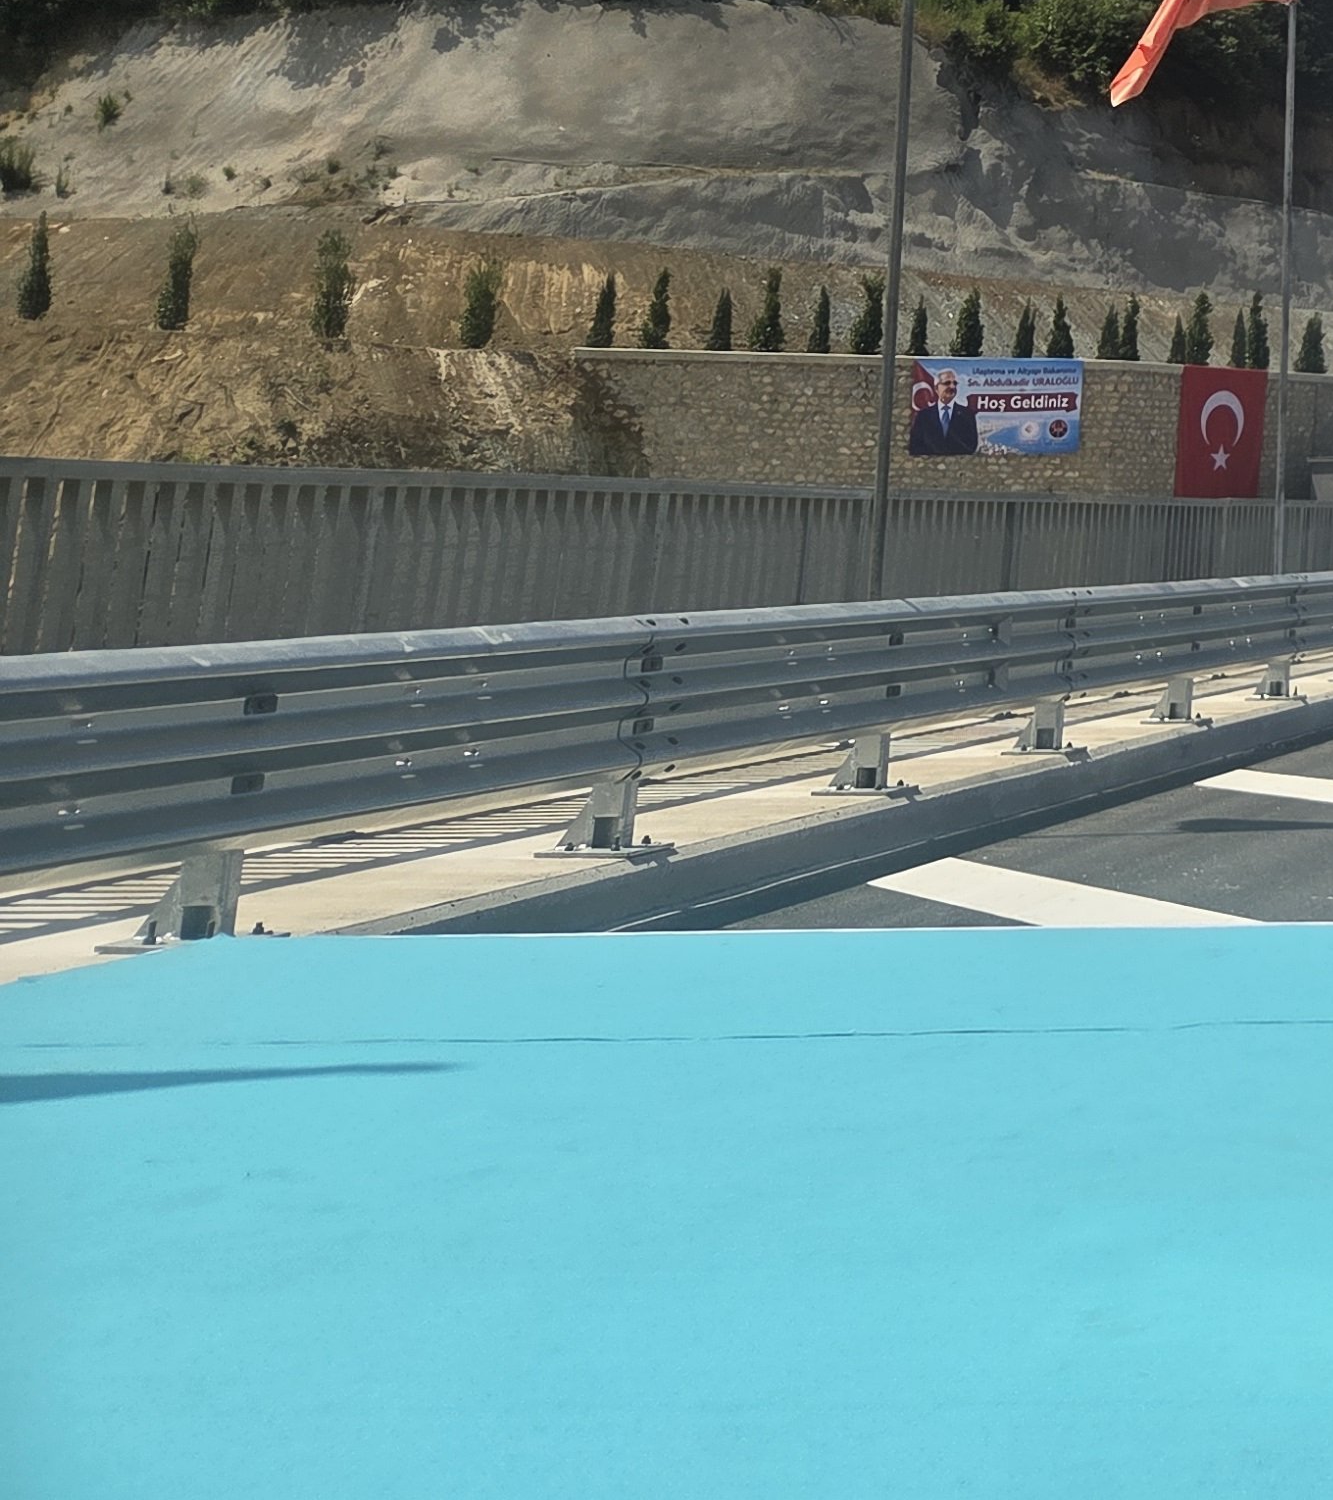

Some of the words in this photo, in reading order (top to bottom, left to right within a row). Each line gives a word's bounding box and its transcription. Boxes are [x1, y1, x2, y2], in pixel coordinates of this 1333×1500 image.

[1032, 376, 1079, 386] URALOĞLU
[977, 395, 1006, 413] Hoş
[1010, 394, 1069, 409] Geldiniz
